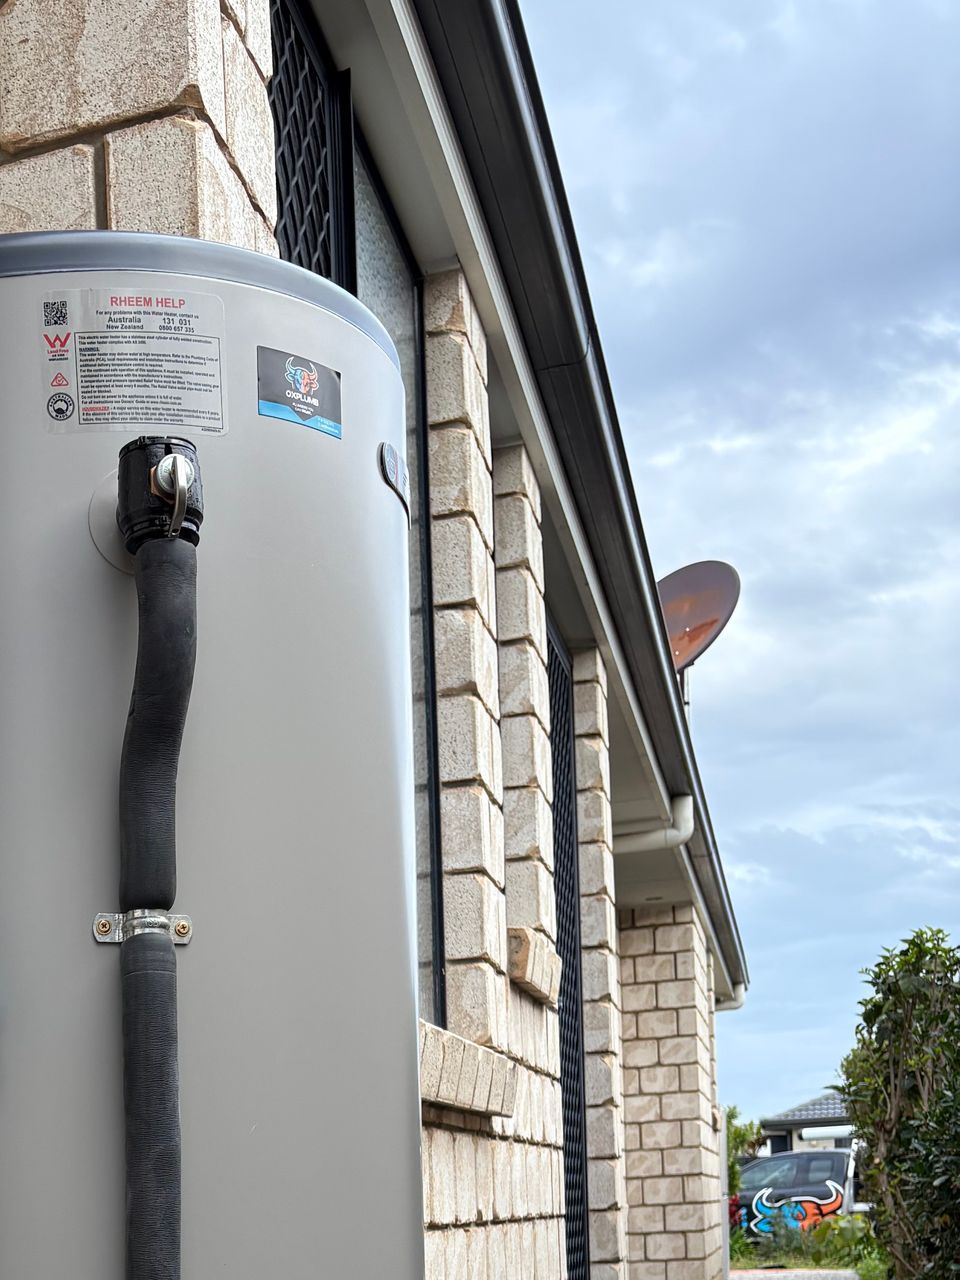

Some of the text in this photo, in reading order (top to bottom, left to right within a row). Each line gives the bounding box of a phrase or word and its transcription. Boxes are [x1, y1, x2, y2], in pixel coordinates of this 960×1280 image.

[110, 296, 186, 309] RHEEM HELP
[179, 318, 191, 326] 031
[286, 390, 319, 407] OXPLUMB
